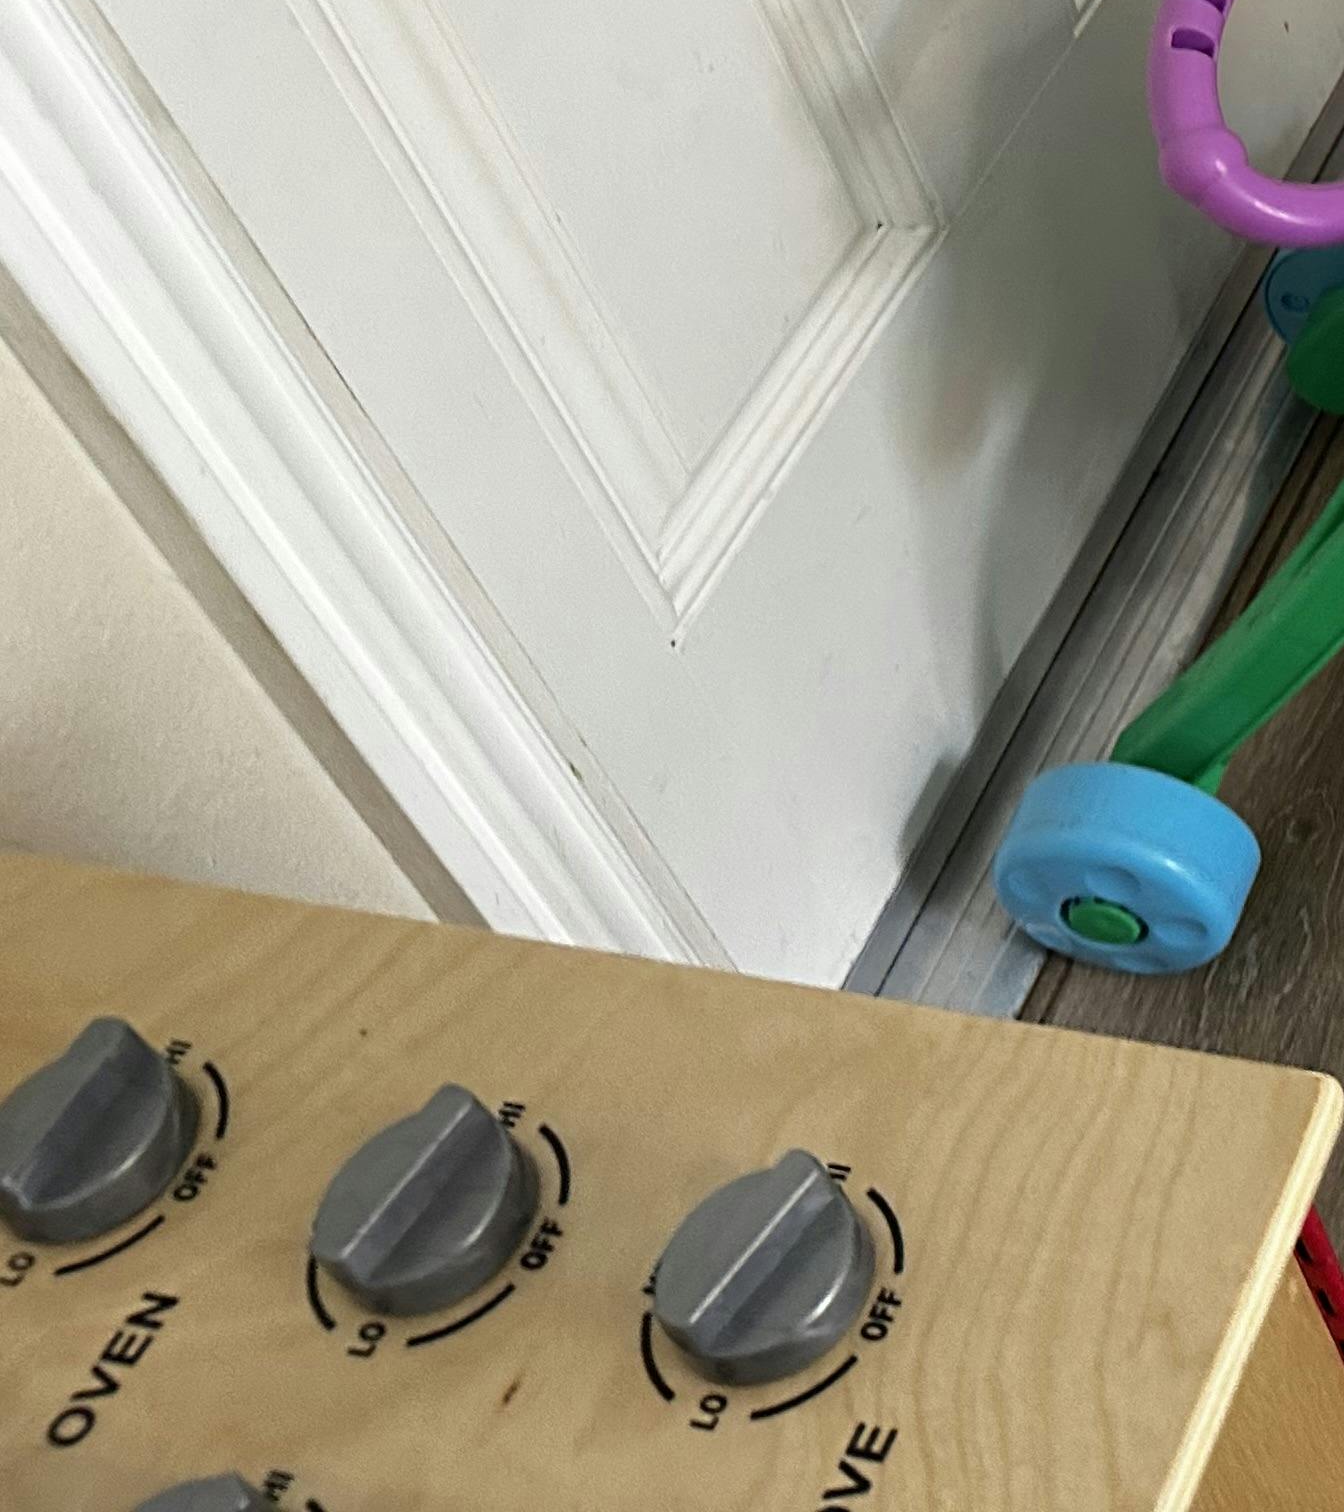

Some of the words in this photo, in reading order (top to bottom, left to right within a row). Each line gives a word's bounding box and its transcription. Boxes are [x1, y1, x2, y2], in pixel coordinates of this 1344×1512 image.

[173, 1153, 217, 1201] OFF
[520, 1217, 564, 1271] OFF
[347, 1321, 387, 1358] LO
[861, 1287, 902, 1341] OFF
[46, 1290, 181, 1448] OVEN
[689, 1394, 729, 1431] LO
[815, 1421, 899, 1512] VE
